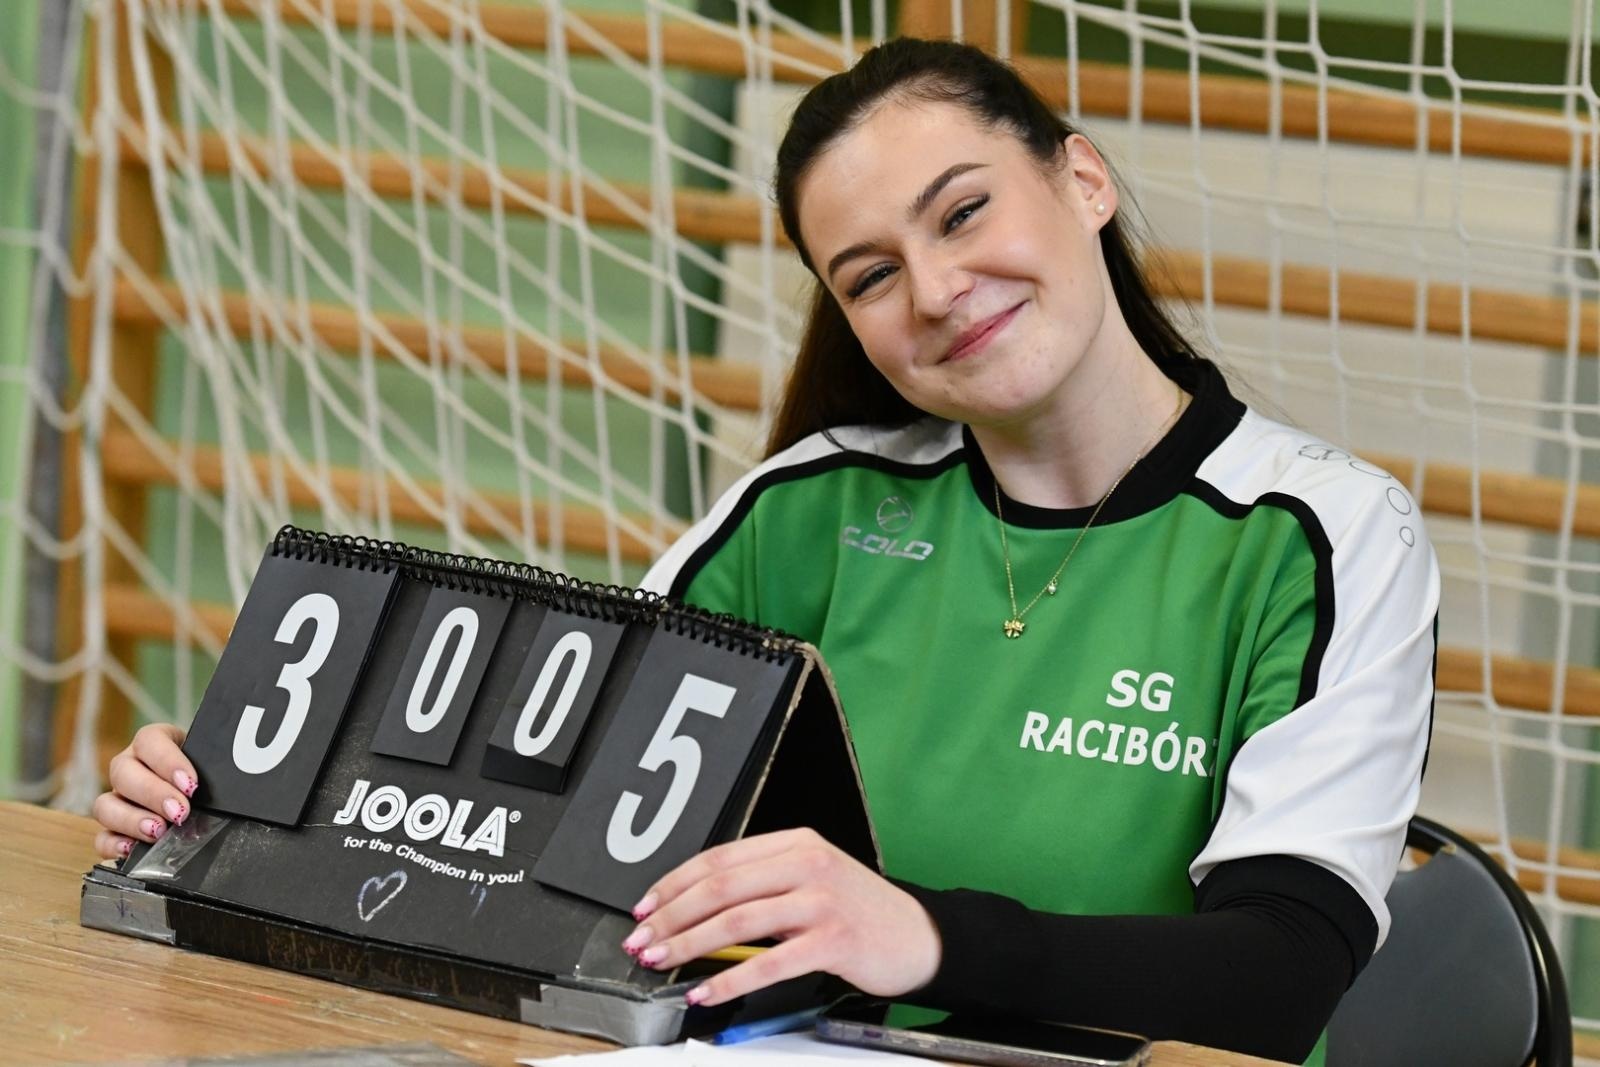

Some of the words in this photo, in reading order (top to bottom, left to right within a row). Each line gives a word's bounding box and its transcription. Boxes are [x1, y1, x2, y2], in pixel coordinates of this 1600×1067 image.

[1105, 669, 1175, 712] SG
[232, 593, 340, 775] 3
[405, 606, 480, 733] 0
[513, 630, 593, 757] 0
[605, 672, 738, 864] 5
[1019, 711, 1217, 777] RACIBÓR
[343, 836, 368, 848] for
[368, 838, 393, 853] the
[395, 844, 467, 880] Champion
[468, 869, 485, 883] in
[486, 869, 525, 886] you!
